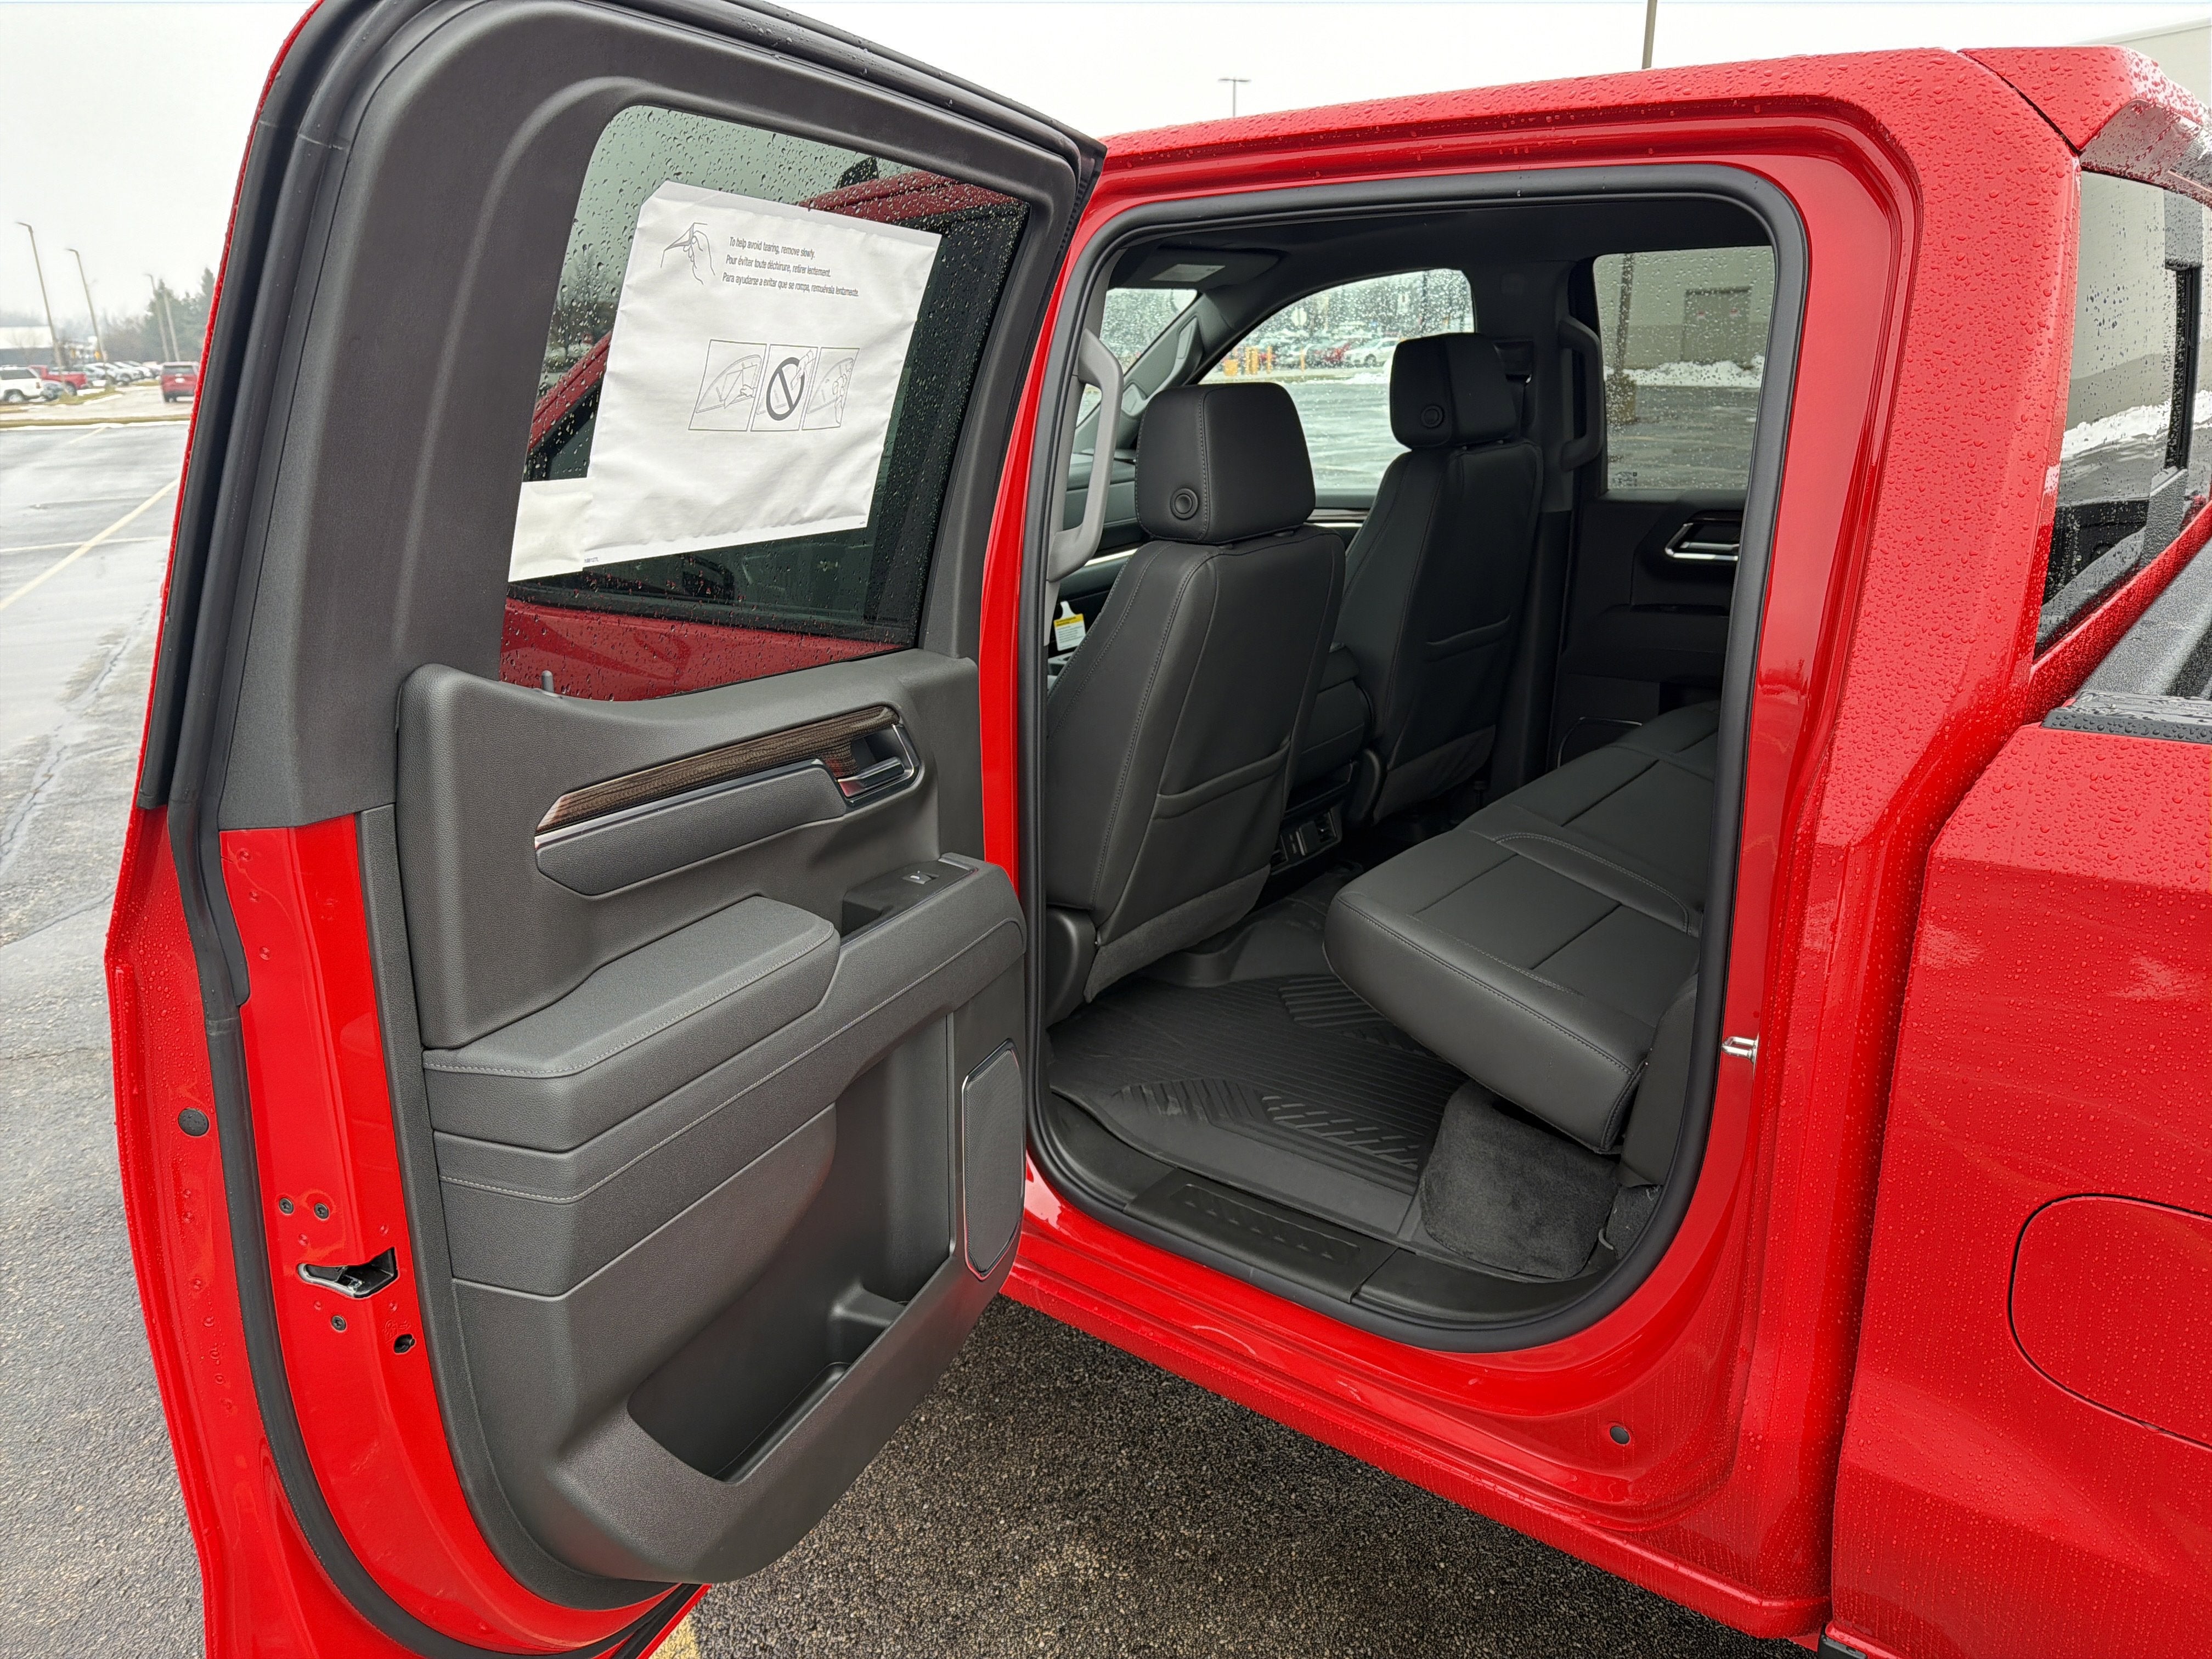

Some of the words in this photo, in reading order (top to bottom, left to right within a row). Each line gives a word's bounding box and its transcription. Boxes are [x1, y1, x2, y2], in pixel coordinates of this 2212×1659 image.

[730, 236, 736, 247] To
[736, 238, 747, 250] help
[747, 241, 762, 250] avoid
[763, 242, 780, 255] tearing,
[781, 246, 800, 256] remove
[726, 254, 737, 264] Pour
[738, 256, 753, 267] éviter
[754, 259, 767, 269] toute
[767, 260, 791, 273] déchirure,
[792, 264, 806, 274] retirer
[723, 272, 734, 282] Para
[736, 275, 759, 286] ayudarse
[764, 278, 777, 287] evitar
[778, 280, 787, 290] que
